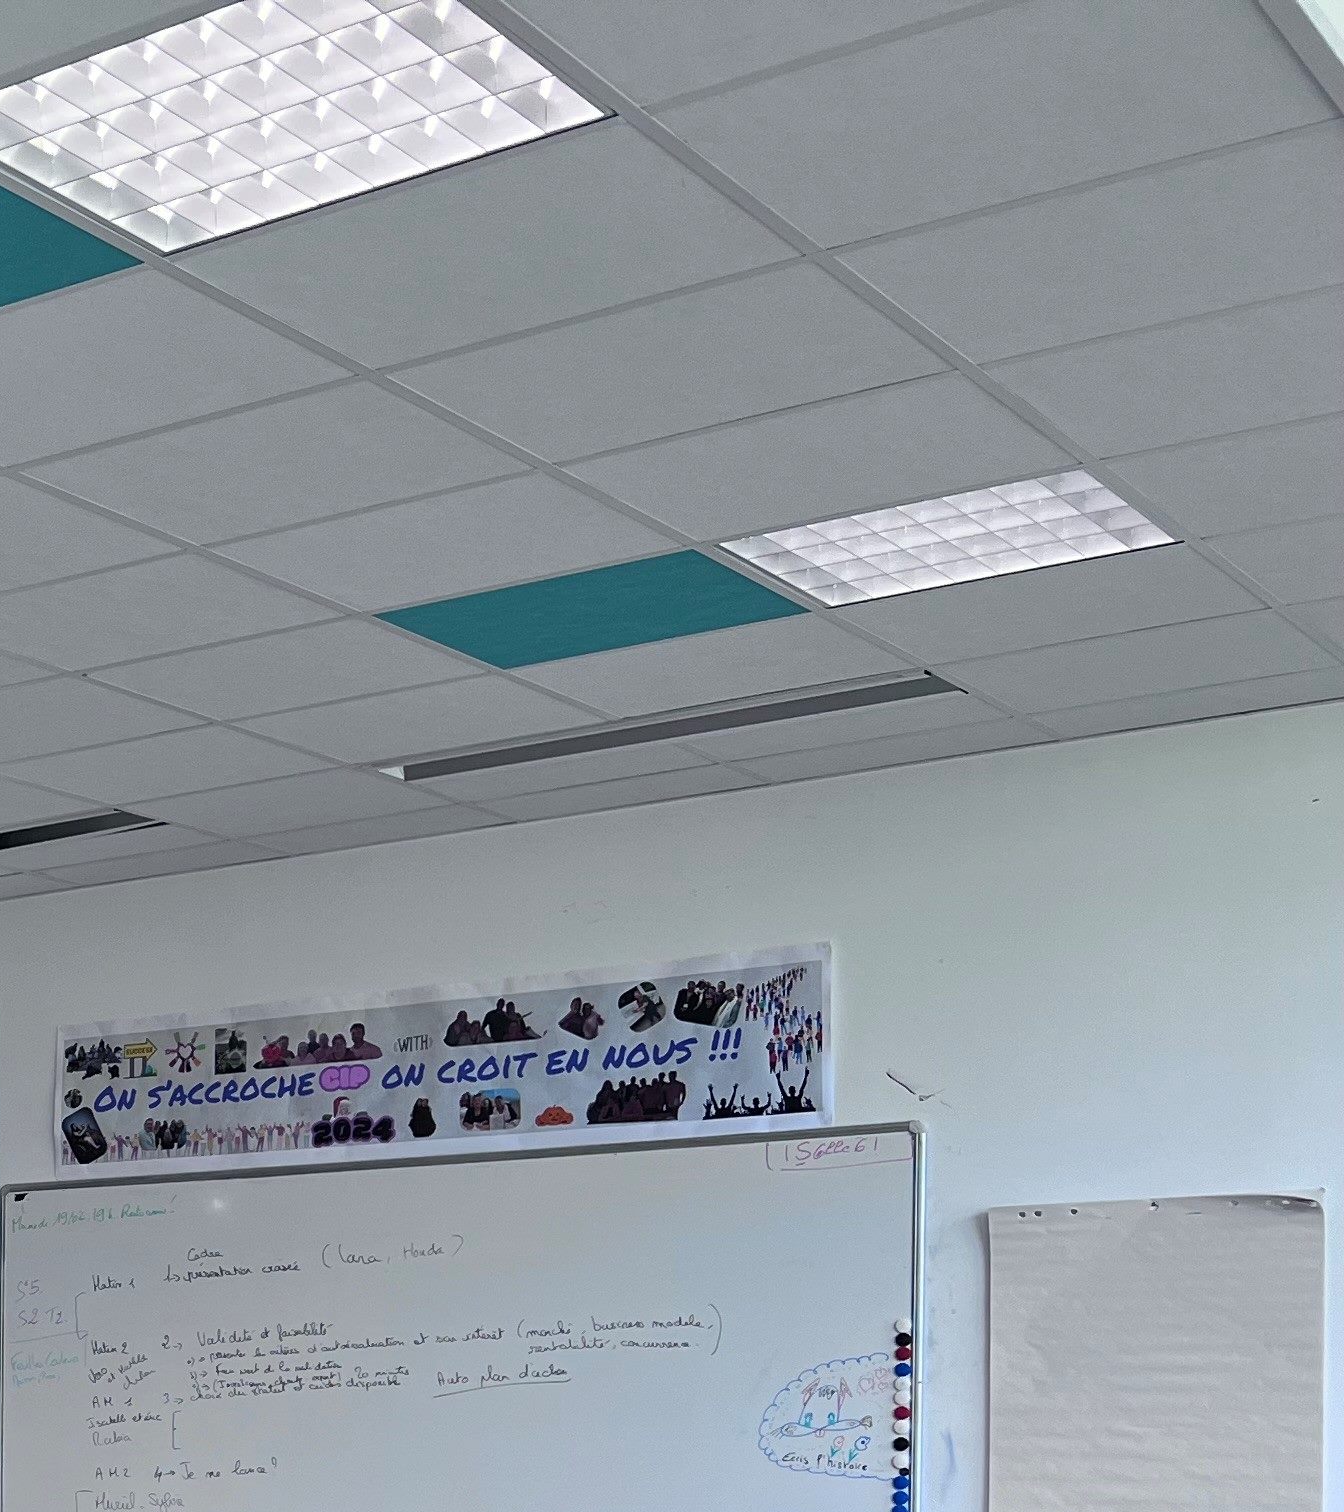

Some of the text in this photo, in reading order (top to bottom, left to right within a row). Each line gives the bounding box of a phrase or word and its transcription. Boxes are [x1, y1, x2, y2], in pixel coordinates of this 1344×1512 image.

[397, 1034, 429, 1053] WITH
[93, 1027, 743, 1113] ON S'ACCROCHE CIP ON CROIT EN NOUS !!!
[312, 1115, 395, 1149] 2024
